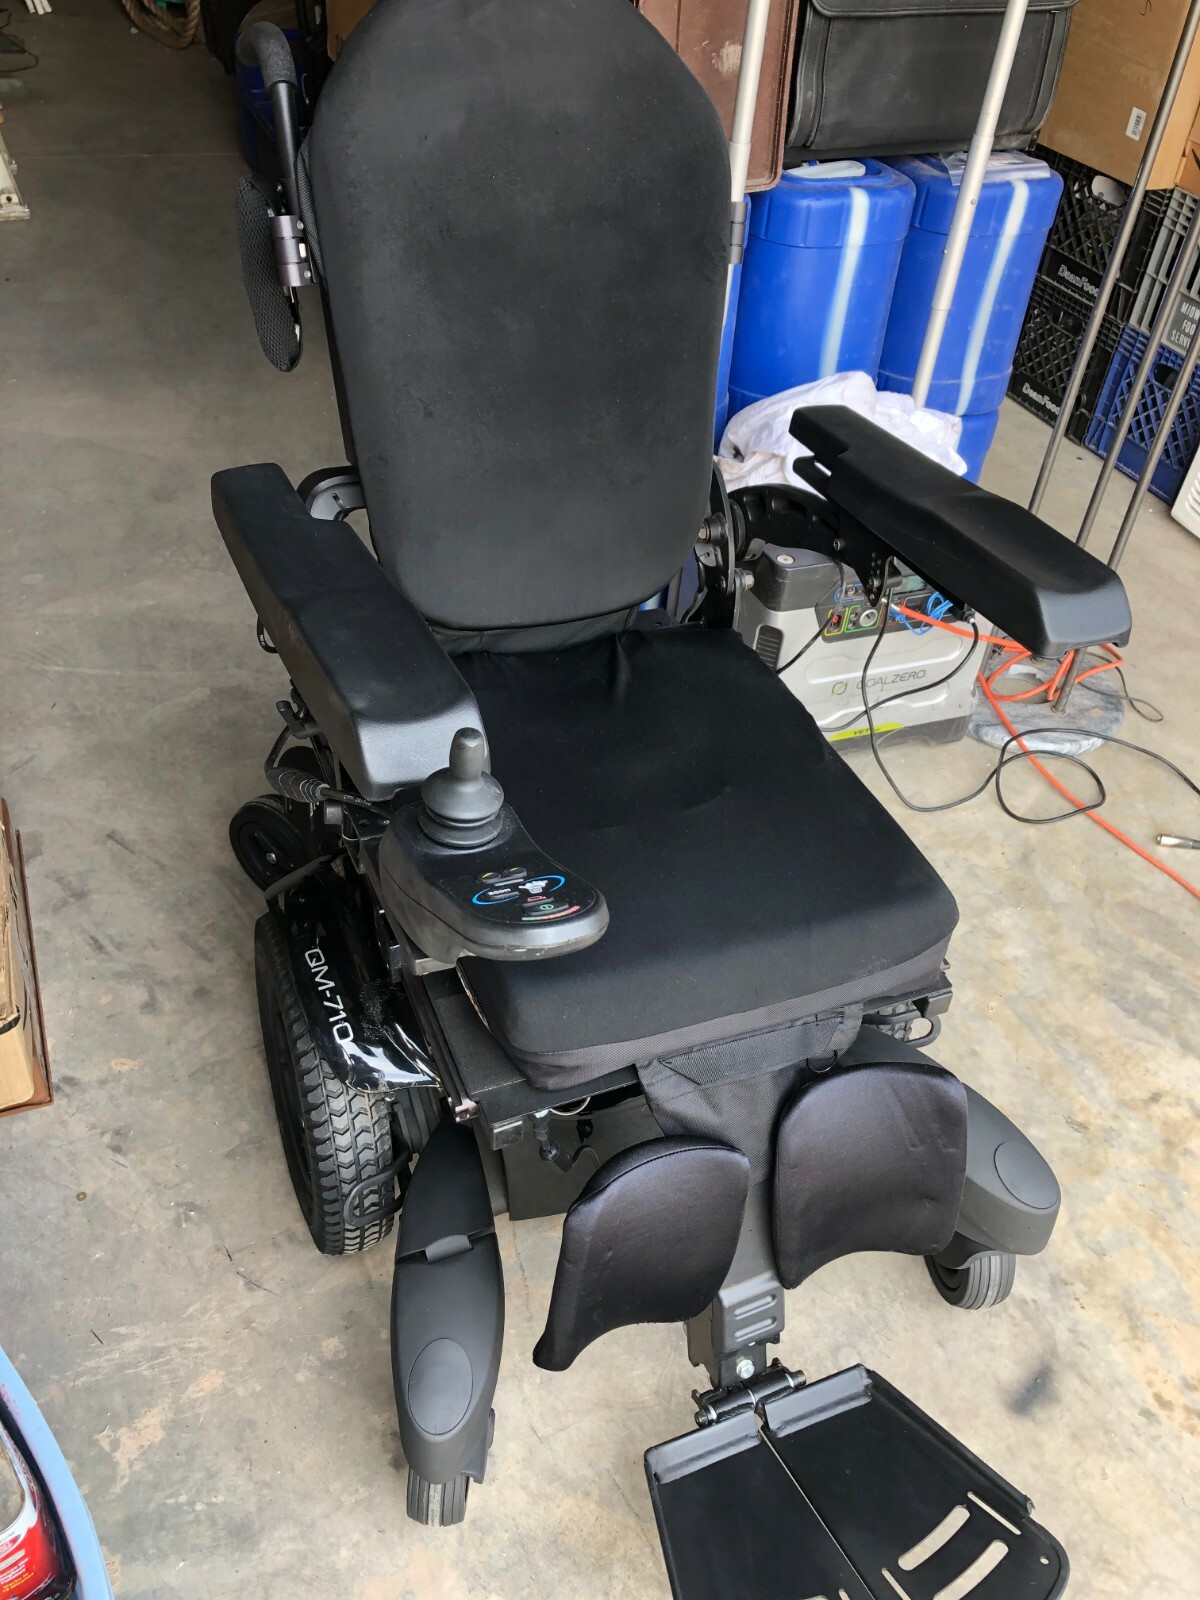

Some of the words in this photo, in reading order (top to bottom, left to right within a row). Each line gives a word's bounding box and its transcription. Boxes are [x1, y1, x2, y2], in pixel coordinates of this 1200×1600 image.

[1180, 301, 1200, 321] MIDW
[1181, 319, 1197, 335] FOO
[1170, 329, 1191, 349] SERVI
[304, 948, 354, 1044] QM-710
